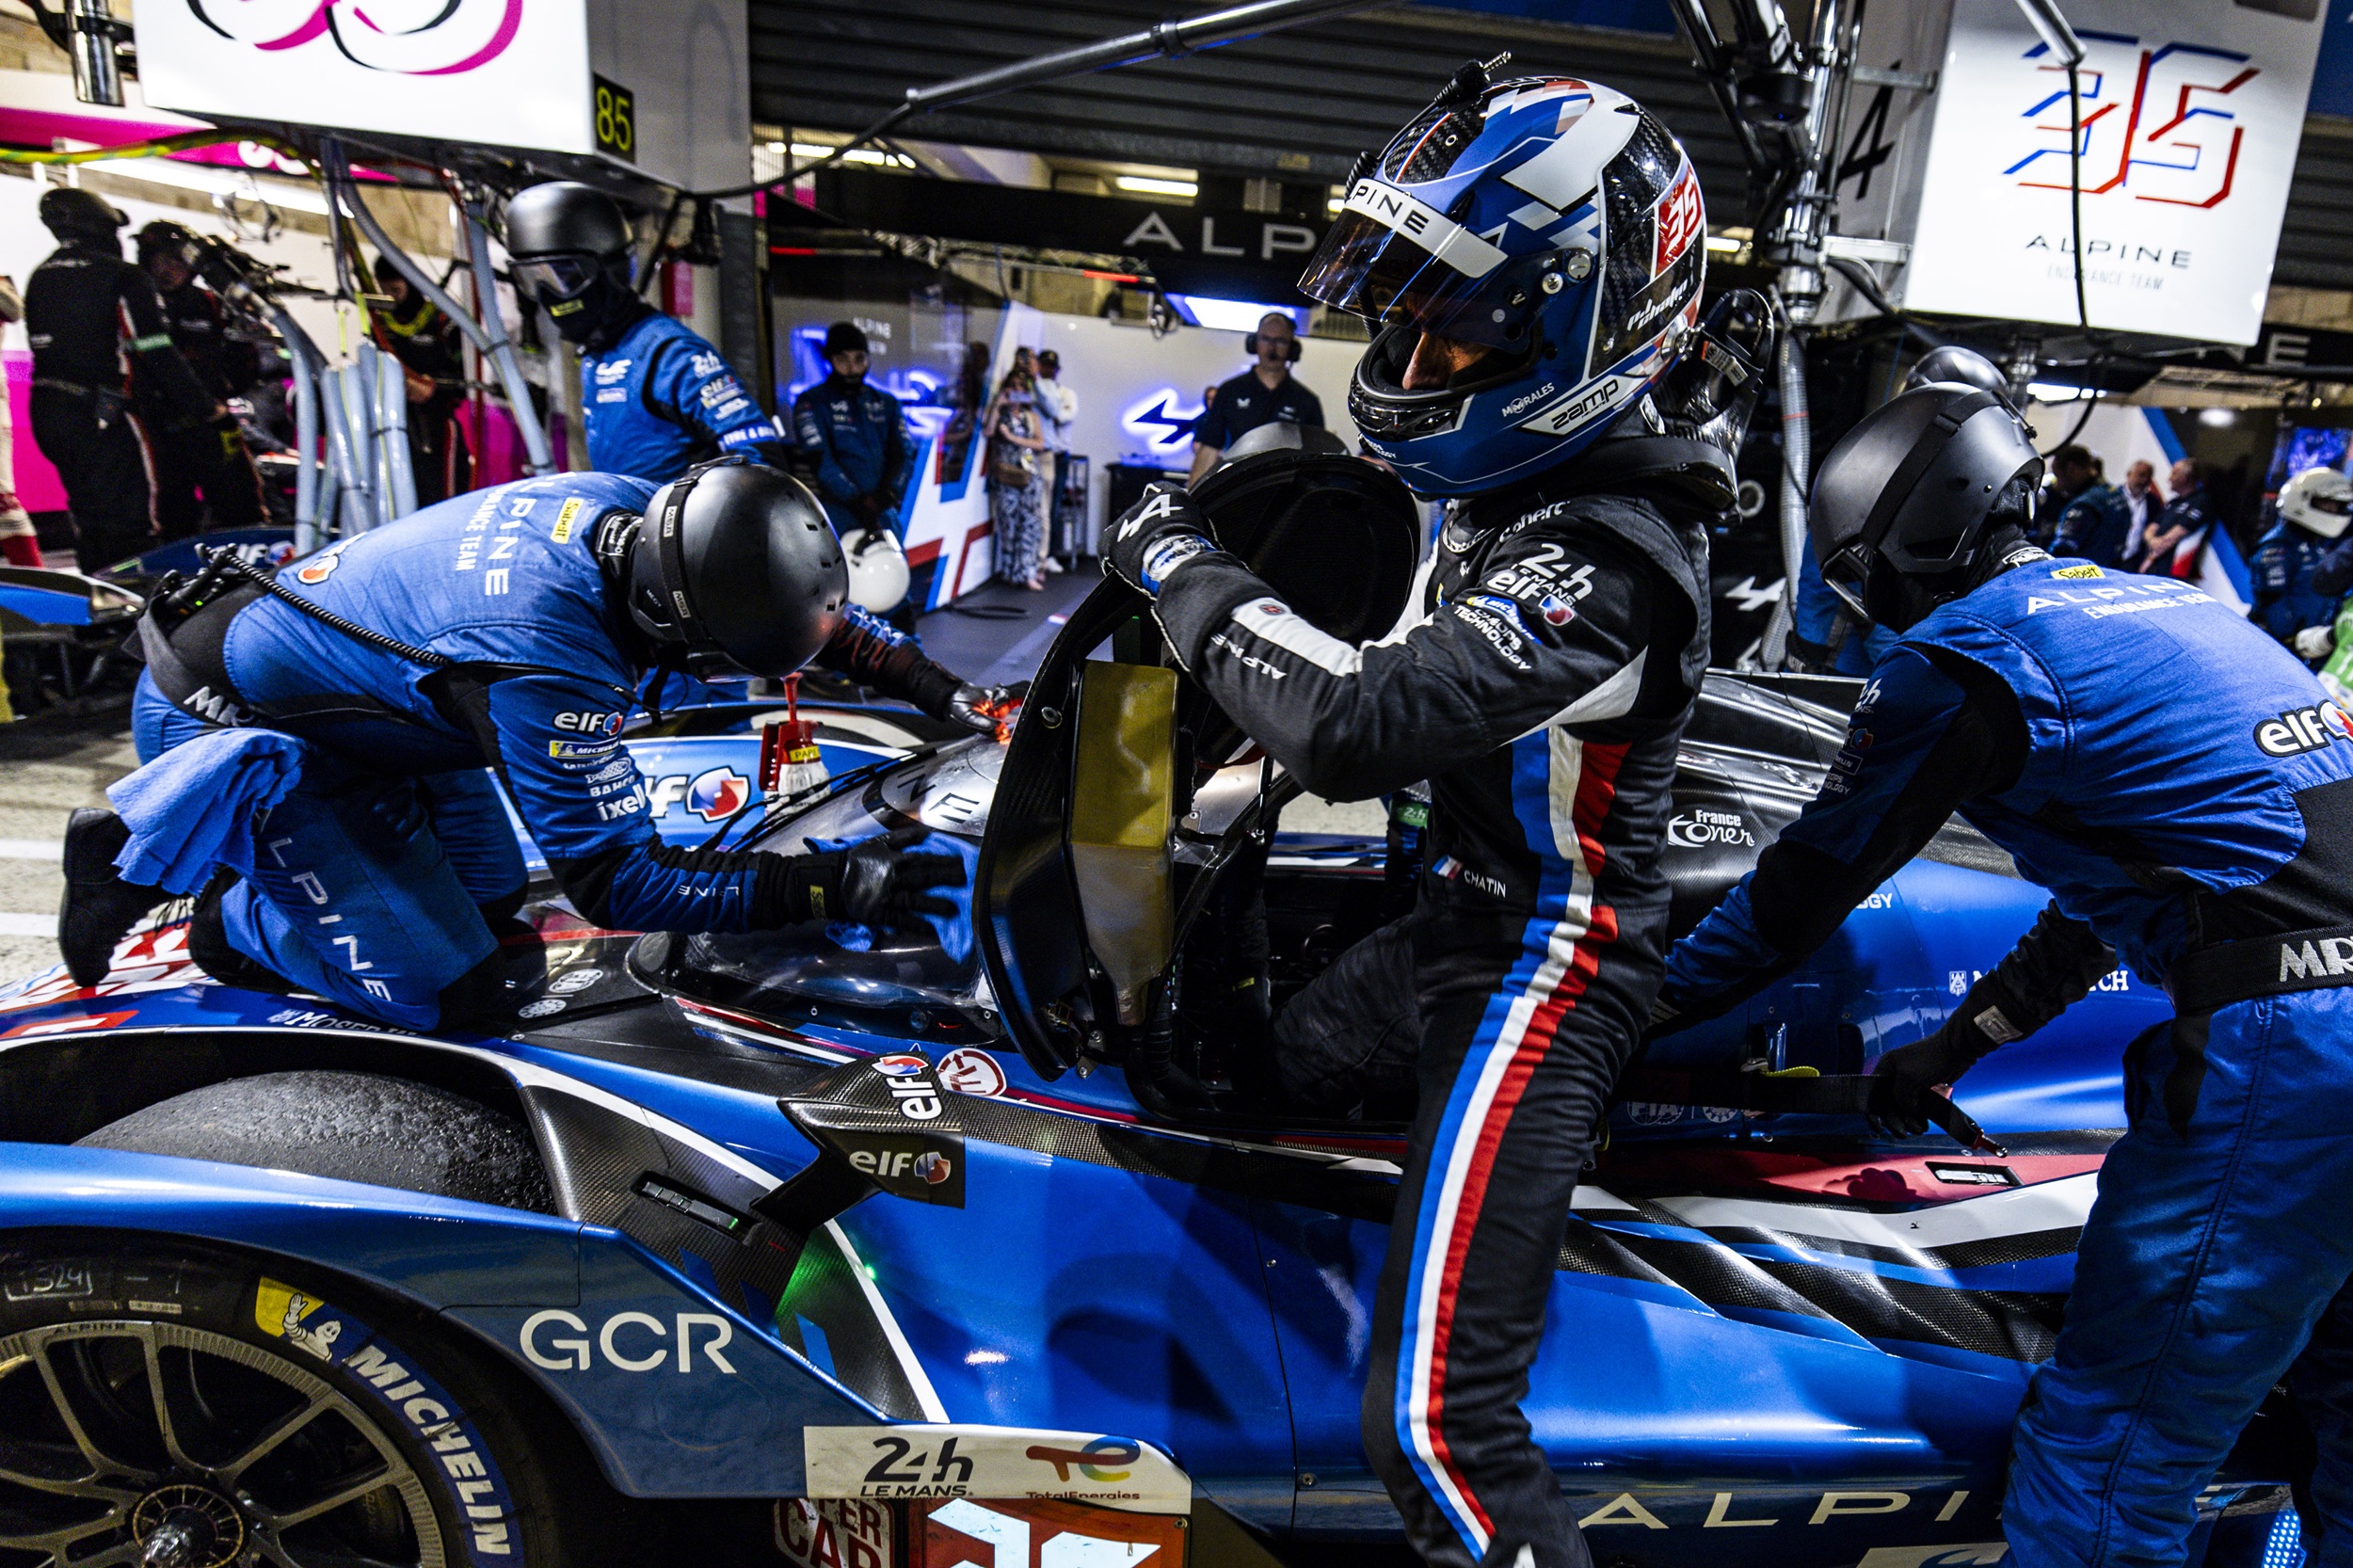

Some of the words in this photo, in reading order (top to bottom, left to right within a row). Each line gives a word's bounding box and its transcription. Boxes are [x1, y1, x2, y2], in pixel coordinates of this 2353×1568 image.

[596, 86, 632, 151] 85
[2025, 235, 2193, 269] ALPINE
[1551, 379, 1620, 430] zamp
[456, 534, 483, 571] TEAM
[1486, 570, 1542, 600] elf
[553, 711, 606, 733] elf
[2259, 709, 2326, 754] elf
[1695, 809, 1742, 827] France
[1464, 869, 1506, 899] CHATIN
[886, 1077, 943, 1121] elf
[849, 1150, 913, 1177] elf
[520, 1309, 737, 1374] GCR
[349, 1344, 511, 1555] MICHELIN
[863, 1436, 974, 1483] 24h
[860, 1485, 891, 1496] LE
[894, 1485, 968, 1497] MANS
[1025, 1491, 1141, 1500] TotalEnergies
